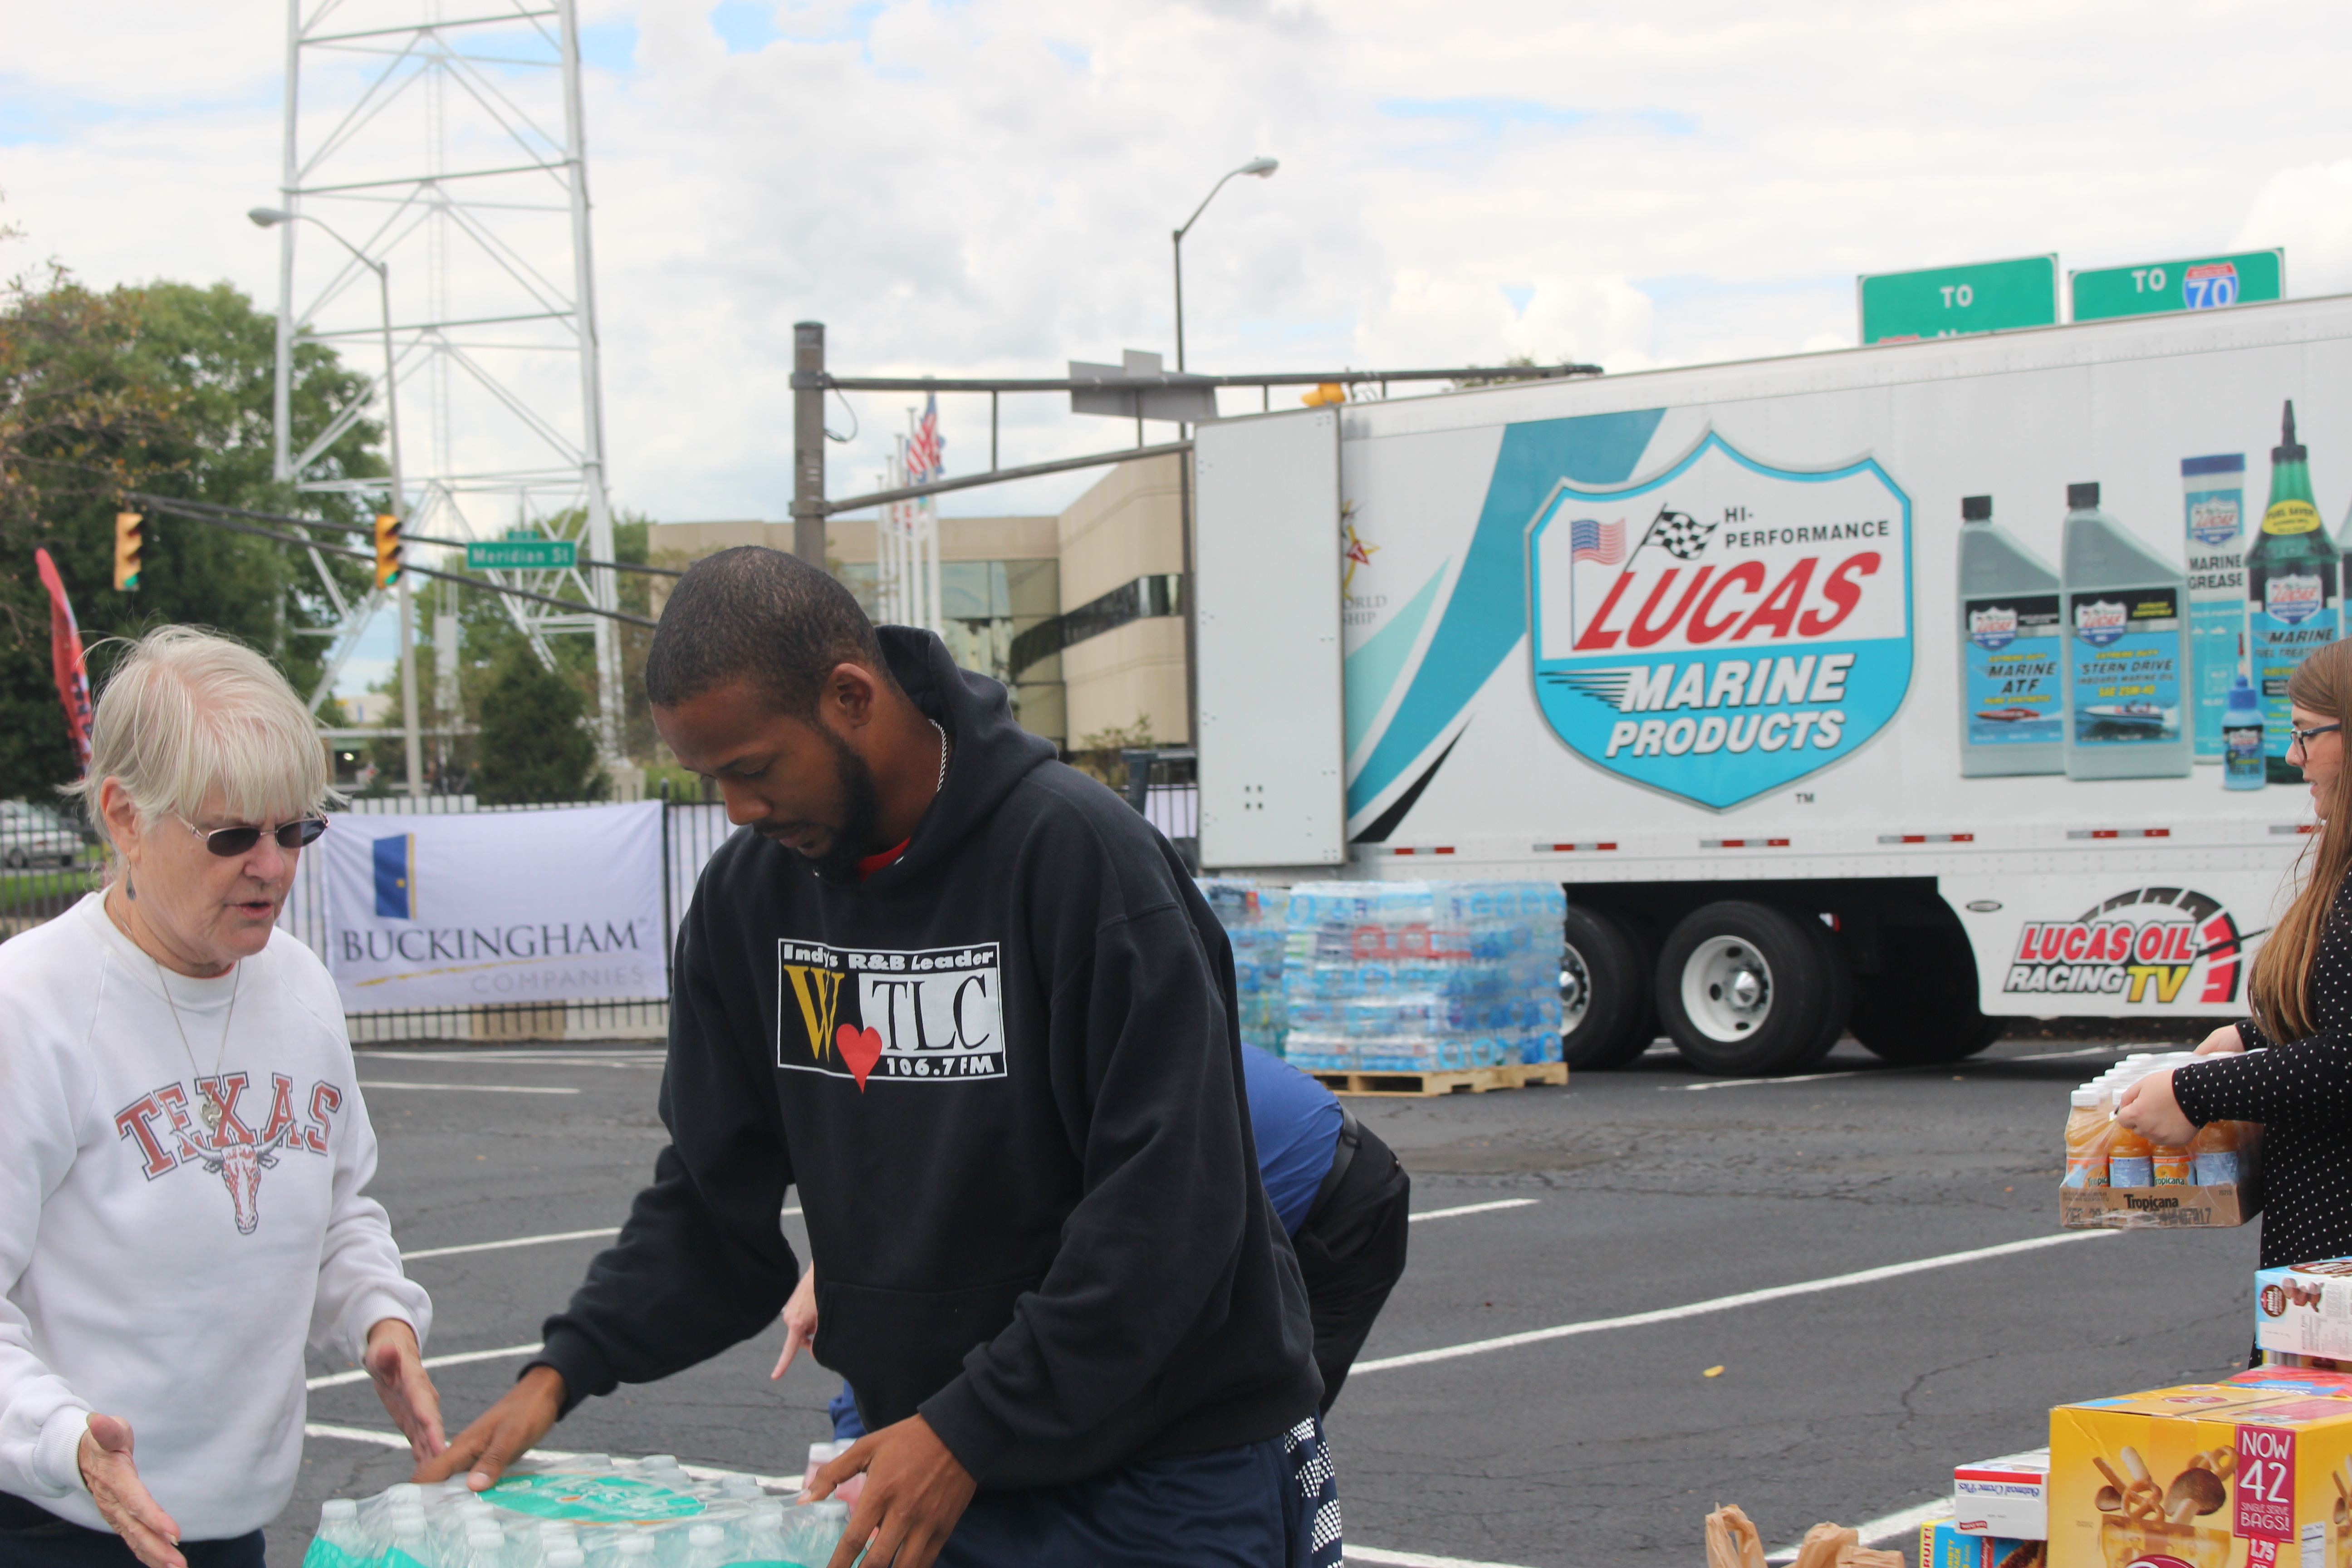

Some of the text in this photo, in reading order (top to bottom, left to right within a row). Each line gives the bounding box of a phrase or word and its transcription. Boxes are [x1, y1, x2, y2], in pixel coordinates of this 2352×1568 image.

[1940, 284, 1974, 308] TO
[2132, 268, 2234, 309] TO 70
[1725, 507, 1753, 524] HI-
[1725, 519, 1890, 549] PERFORMANCE
[2190, 554, 2242, 570] MARINE
[2189, 573, 2243, 589] GREASE
[1572, 552, 1882, 651] LUCAS
[2269, 628, 2334, 644] MARINE
[1988, 661, 2058, 679] MARINE
[2082, 659, 2174, 675] STERN DRIVE
[1620, 653, 1856, 713] MARINE
[2000, 679, 2041, 695] ATF
[1605, 710, 1845, 758] PRODUCTS
[1796, 793, 1814, 803] TM
[342, 919, 640, 962] BUCKINGHAM
[2018, 923, 2197, 961] LUCAS OIL
[848, 953, 906, 970] R&B
[911, 950, 994, 970] Leader
[471, 965, 643, 995] COMPANIES
[114, 1071, 342, 1181] TEXAS
[2123, 1194, 2179, 1210] Tropicana
[2242, 1431, 2291, 1460] NOW
[2239, 1459, 2289, 1503] 42
[2240, 1502, 2289, 1516] SINGLE SERVE
[2240, 1511, 2290, 1532] BAGS!
[2250, 1538, 2276, 1562] 1.75
